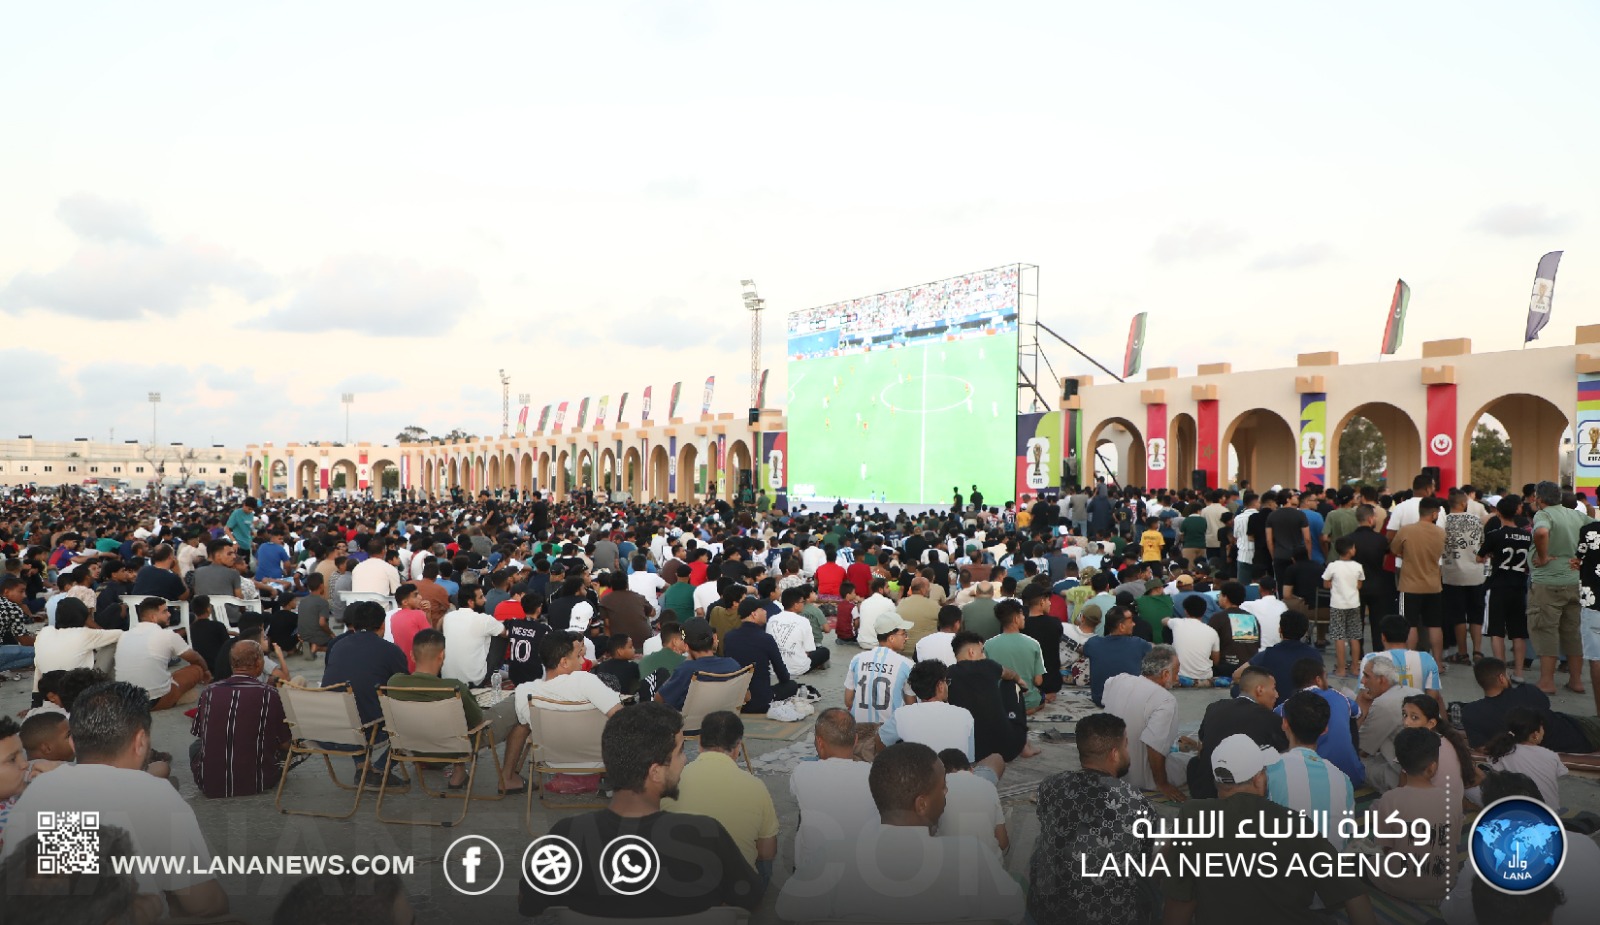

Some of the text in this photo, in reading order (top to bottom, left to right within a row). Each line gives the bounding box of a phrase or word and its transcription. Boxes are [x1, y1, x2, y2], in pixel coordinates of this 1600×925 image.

[1499, 547, 1528, 572] 22
[511, 626, 536, 638] MESSI
[510, 637, 531, 662] 10
[861, 661, 894, 675] MESSI
[858, 674, 891, 710] 10
